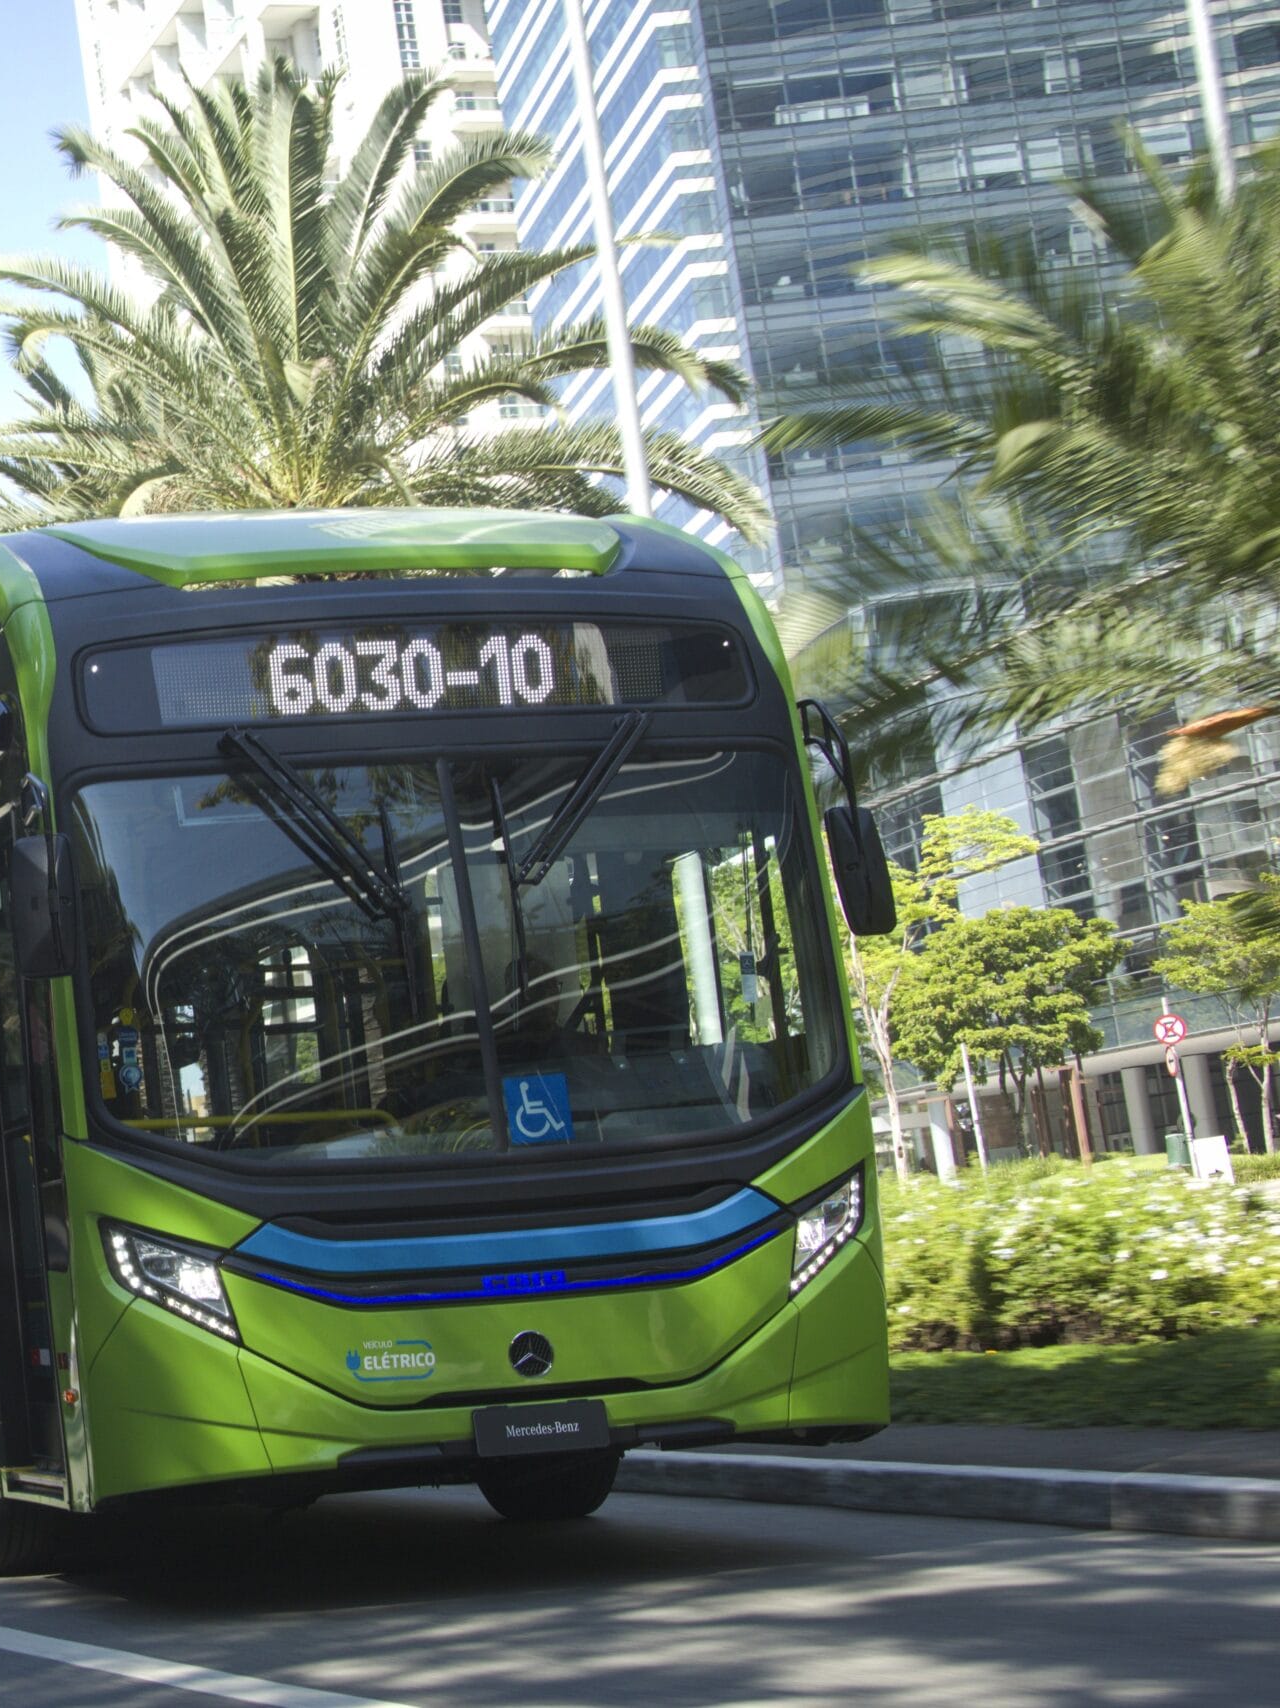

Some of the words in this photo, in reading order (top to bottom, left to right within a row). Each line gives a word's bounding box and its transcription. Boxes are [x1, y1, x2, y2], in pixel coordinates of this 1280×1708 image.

[269, 634, 553, 714] 6030-10
[362, 1339, 393, 1349] VEÍCULO
[363, 1350, 436, 1371] ELÉTRICO
[505, 1421, 580, 1438] Mercedes-Benz
